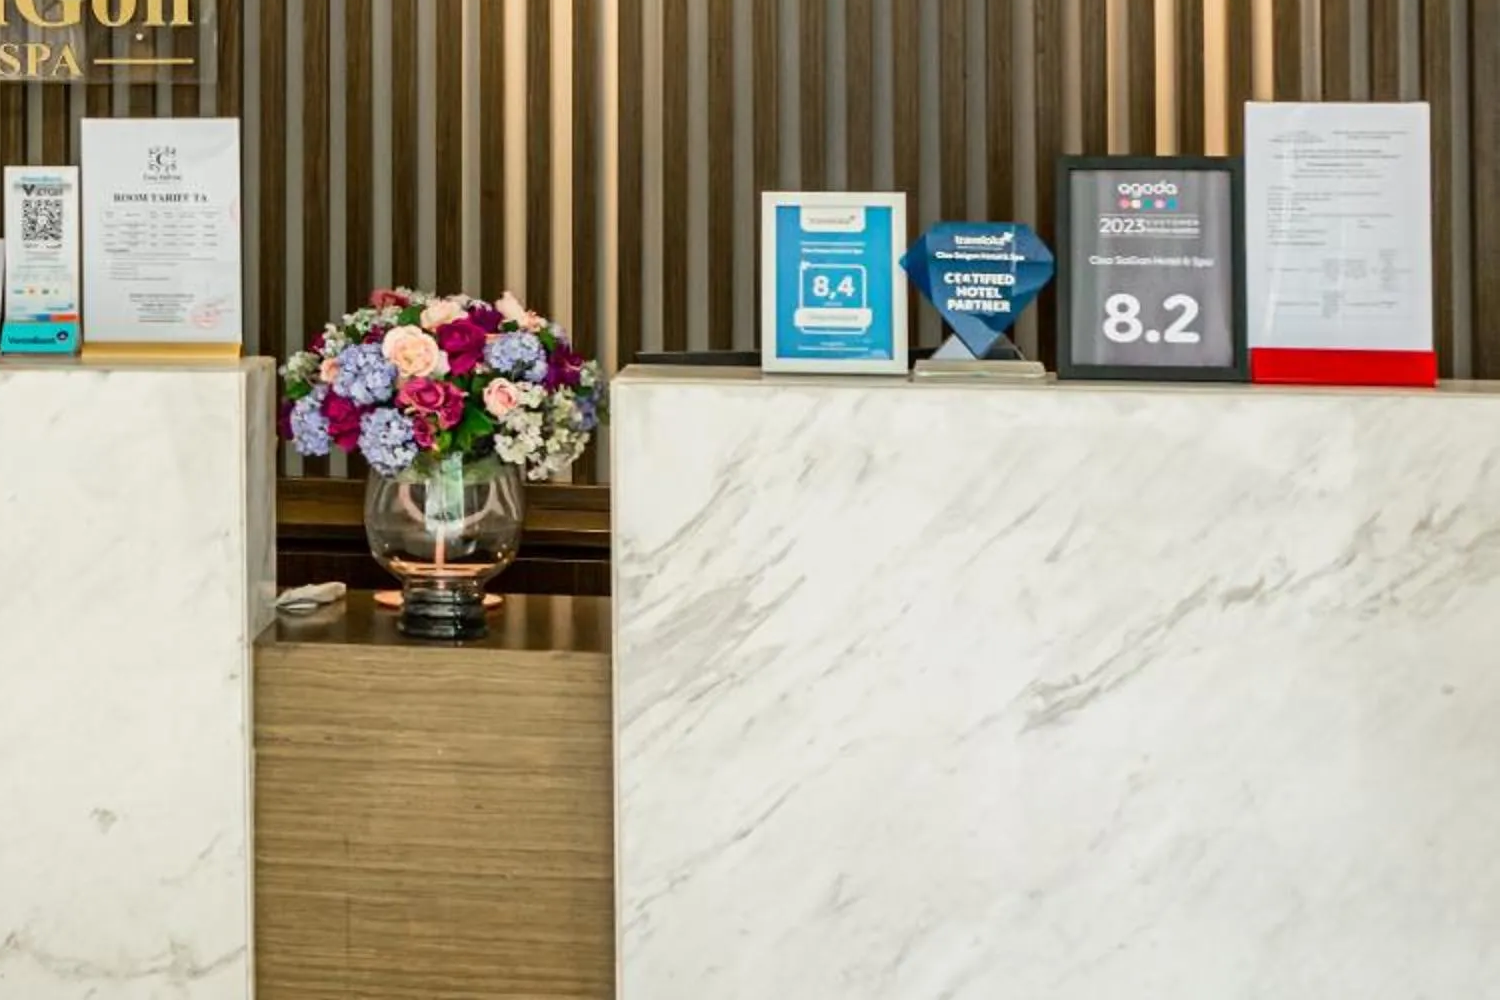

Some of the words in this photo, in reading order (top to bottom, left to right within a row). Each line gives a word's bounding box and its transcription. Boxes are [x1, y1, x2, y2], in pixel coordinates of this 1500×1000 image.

[1117, 180, 1179, 199] agoda
[1099, 217, 1146, 234] 2023
[943, 271, 1016, 286] CERTIFIED
[812, 275, 856, 300] 8,4
[955, 285, 1003, 299] HOTEL
[946, 298, 1012, 314] PARTNER
[1102, 292, 1202, 344] 8.2
